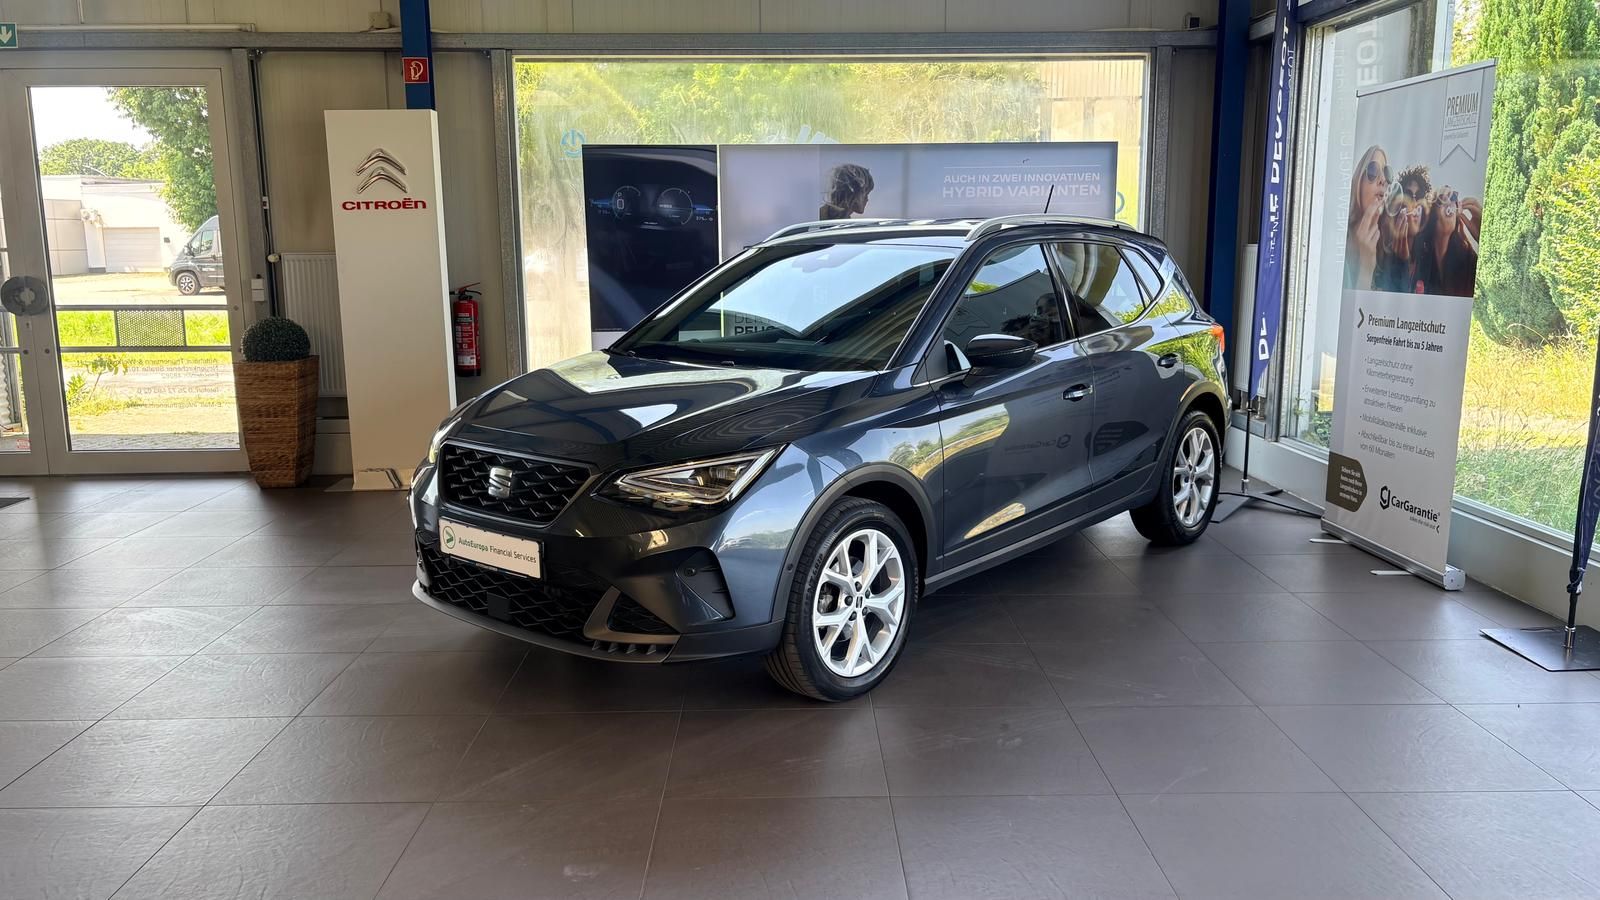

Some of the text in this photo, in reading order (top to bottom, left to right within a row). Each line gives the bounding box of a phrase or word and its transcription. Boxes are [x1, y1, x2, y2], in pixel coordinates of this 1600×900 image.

[1447, 92, 1479, 116] PREMIUM
[944, 172, 1100, 184] AUCH IN ZWEI INNOVATIVEN
[943, 184, 1101, 199] HYBRID VARIANTEN
[1368, 313, 1446, 335] Premium Langzeitschutz
[1366, 333, 1392, 346] Sorgenfreie
[1393, 336, 1406, 348] Fahrt
[1414, 342, 1420, 350] zu
[1421, 341, 1425, 351] 5
[1425, 341, 1443, 353] Jahren
[458, 536, 537, 564] AutoEuropa Financial Services
